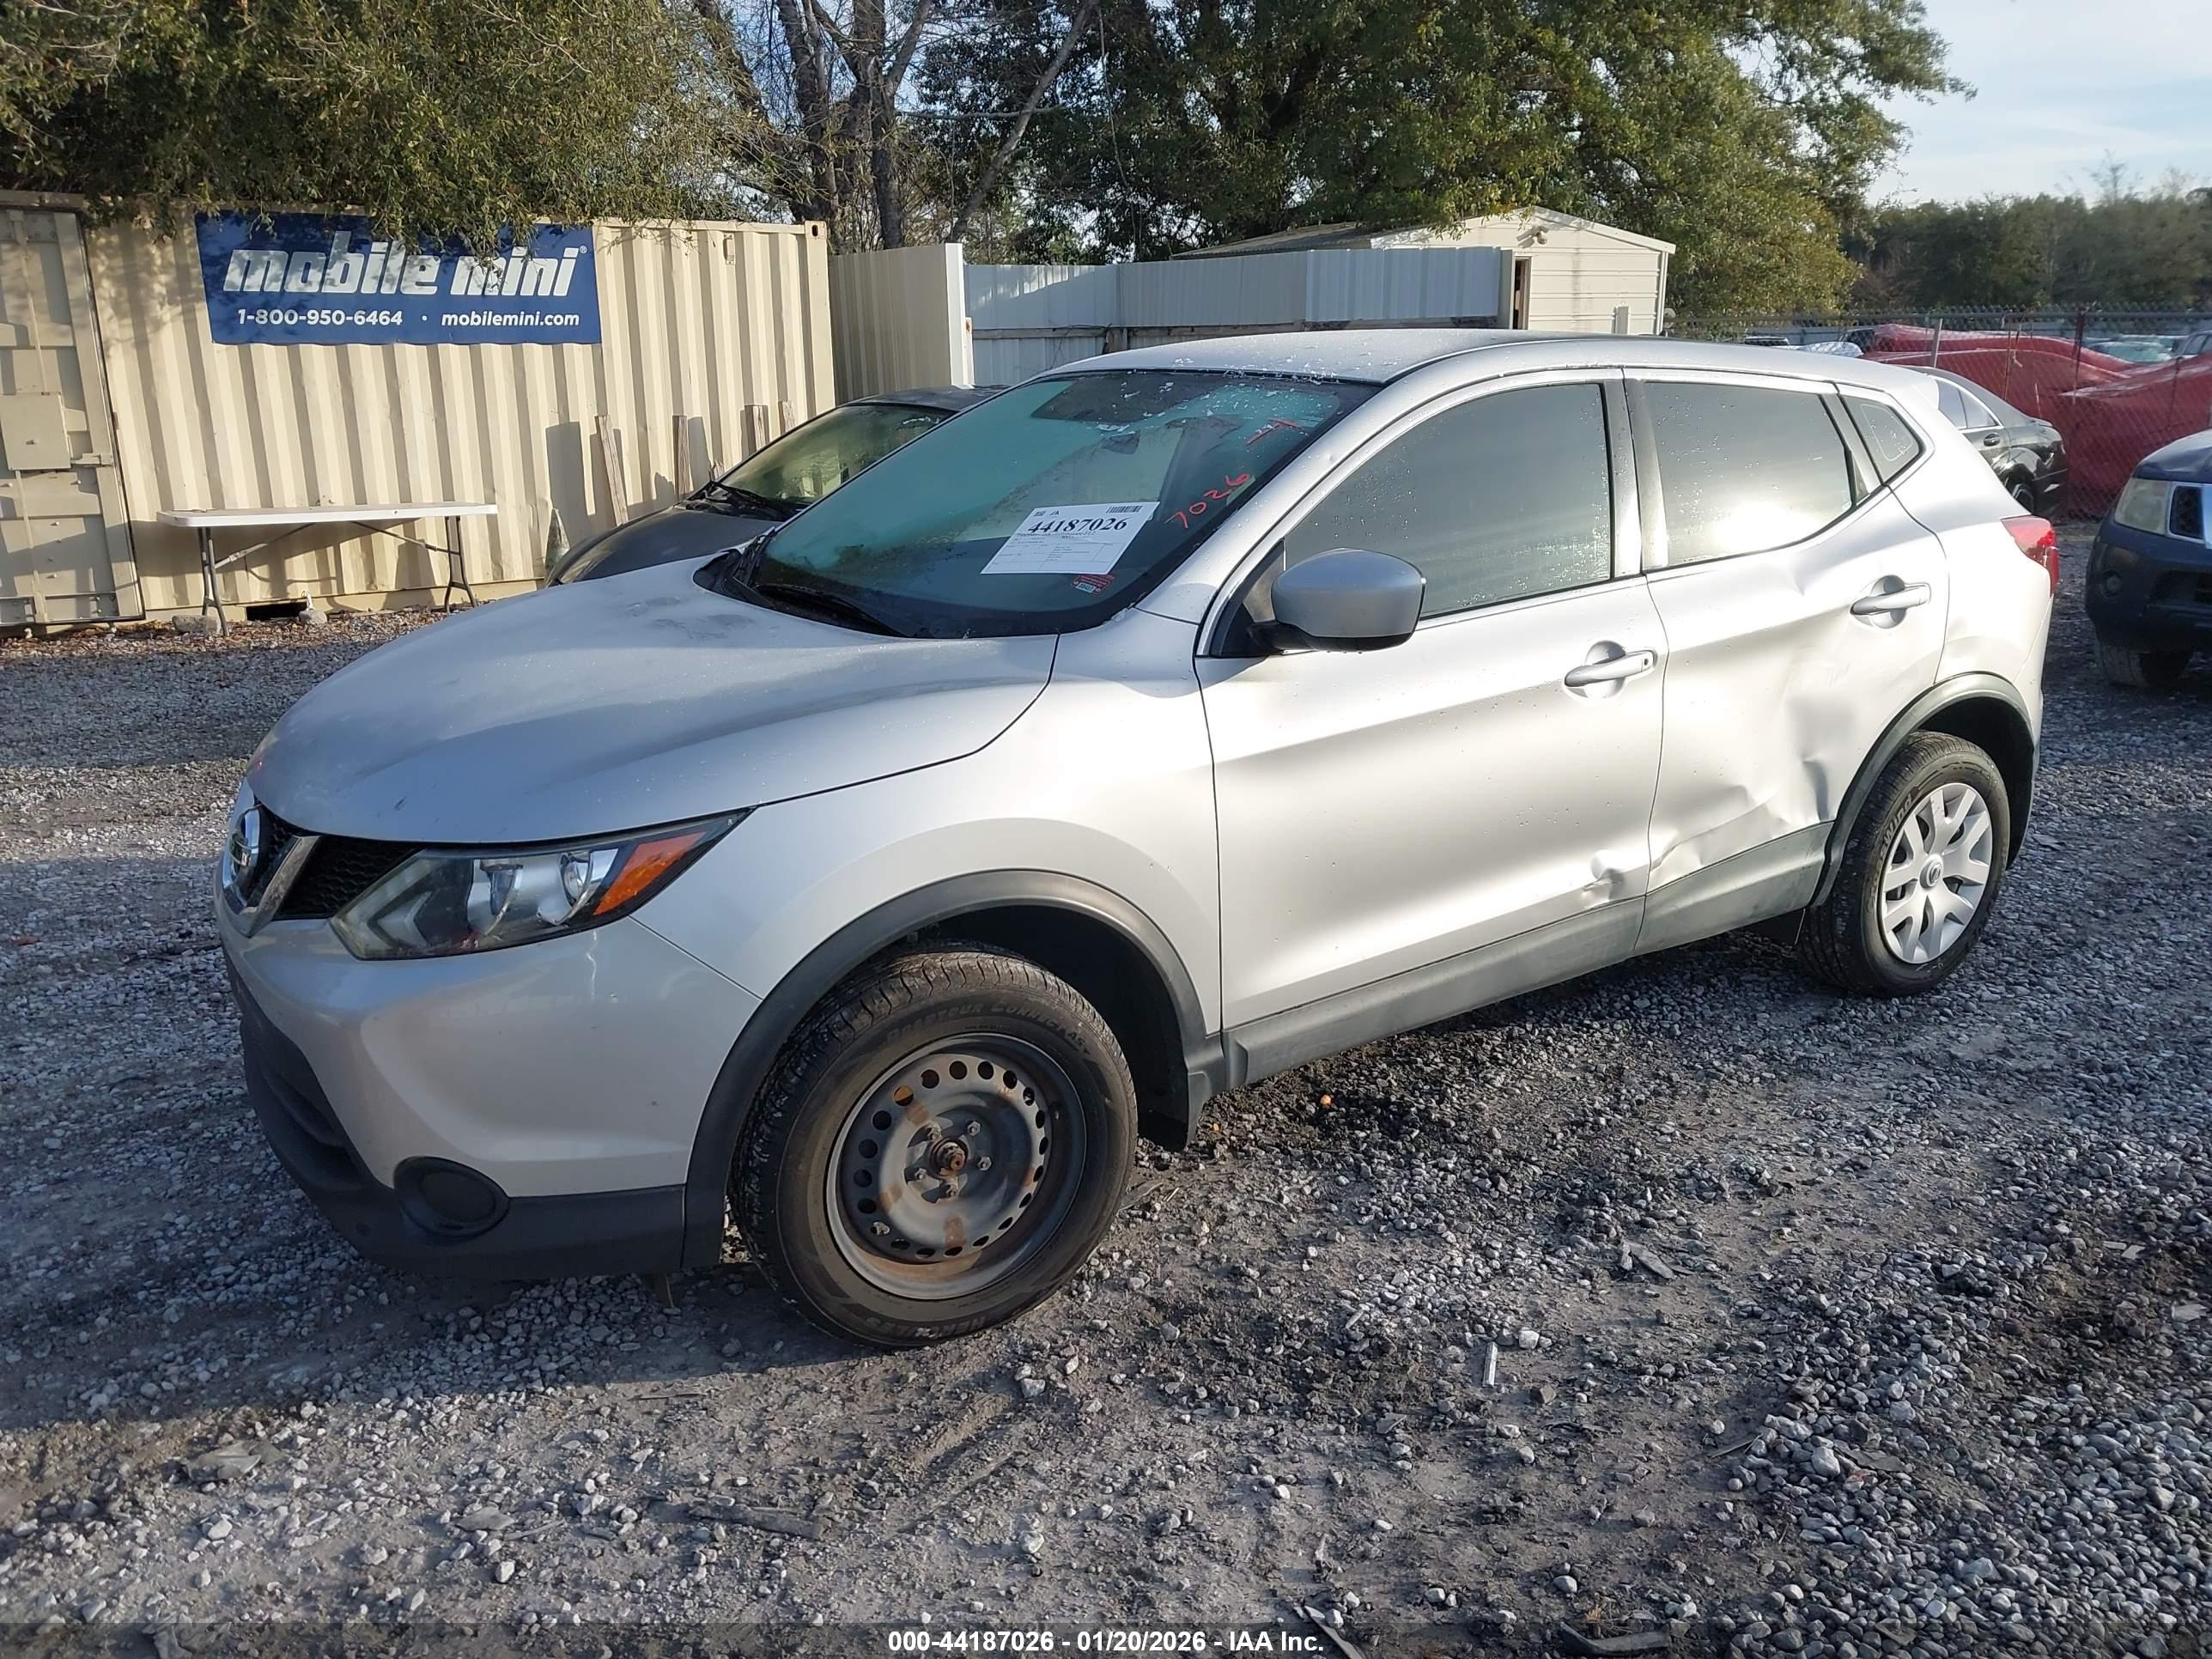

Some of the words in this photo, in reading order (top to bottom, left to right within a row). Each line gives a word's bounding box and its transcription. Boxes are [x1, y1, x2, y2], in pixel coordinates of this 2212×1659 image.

[223, 230, 441, 295] mobile
[238, 308, 403, 326] 1-800-950-6464
[441, 310, 580, 326] mobilemini.com
[1164, 473, 1251, 529] 7026
[1028, 517, 1131, 533] 44187026
